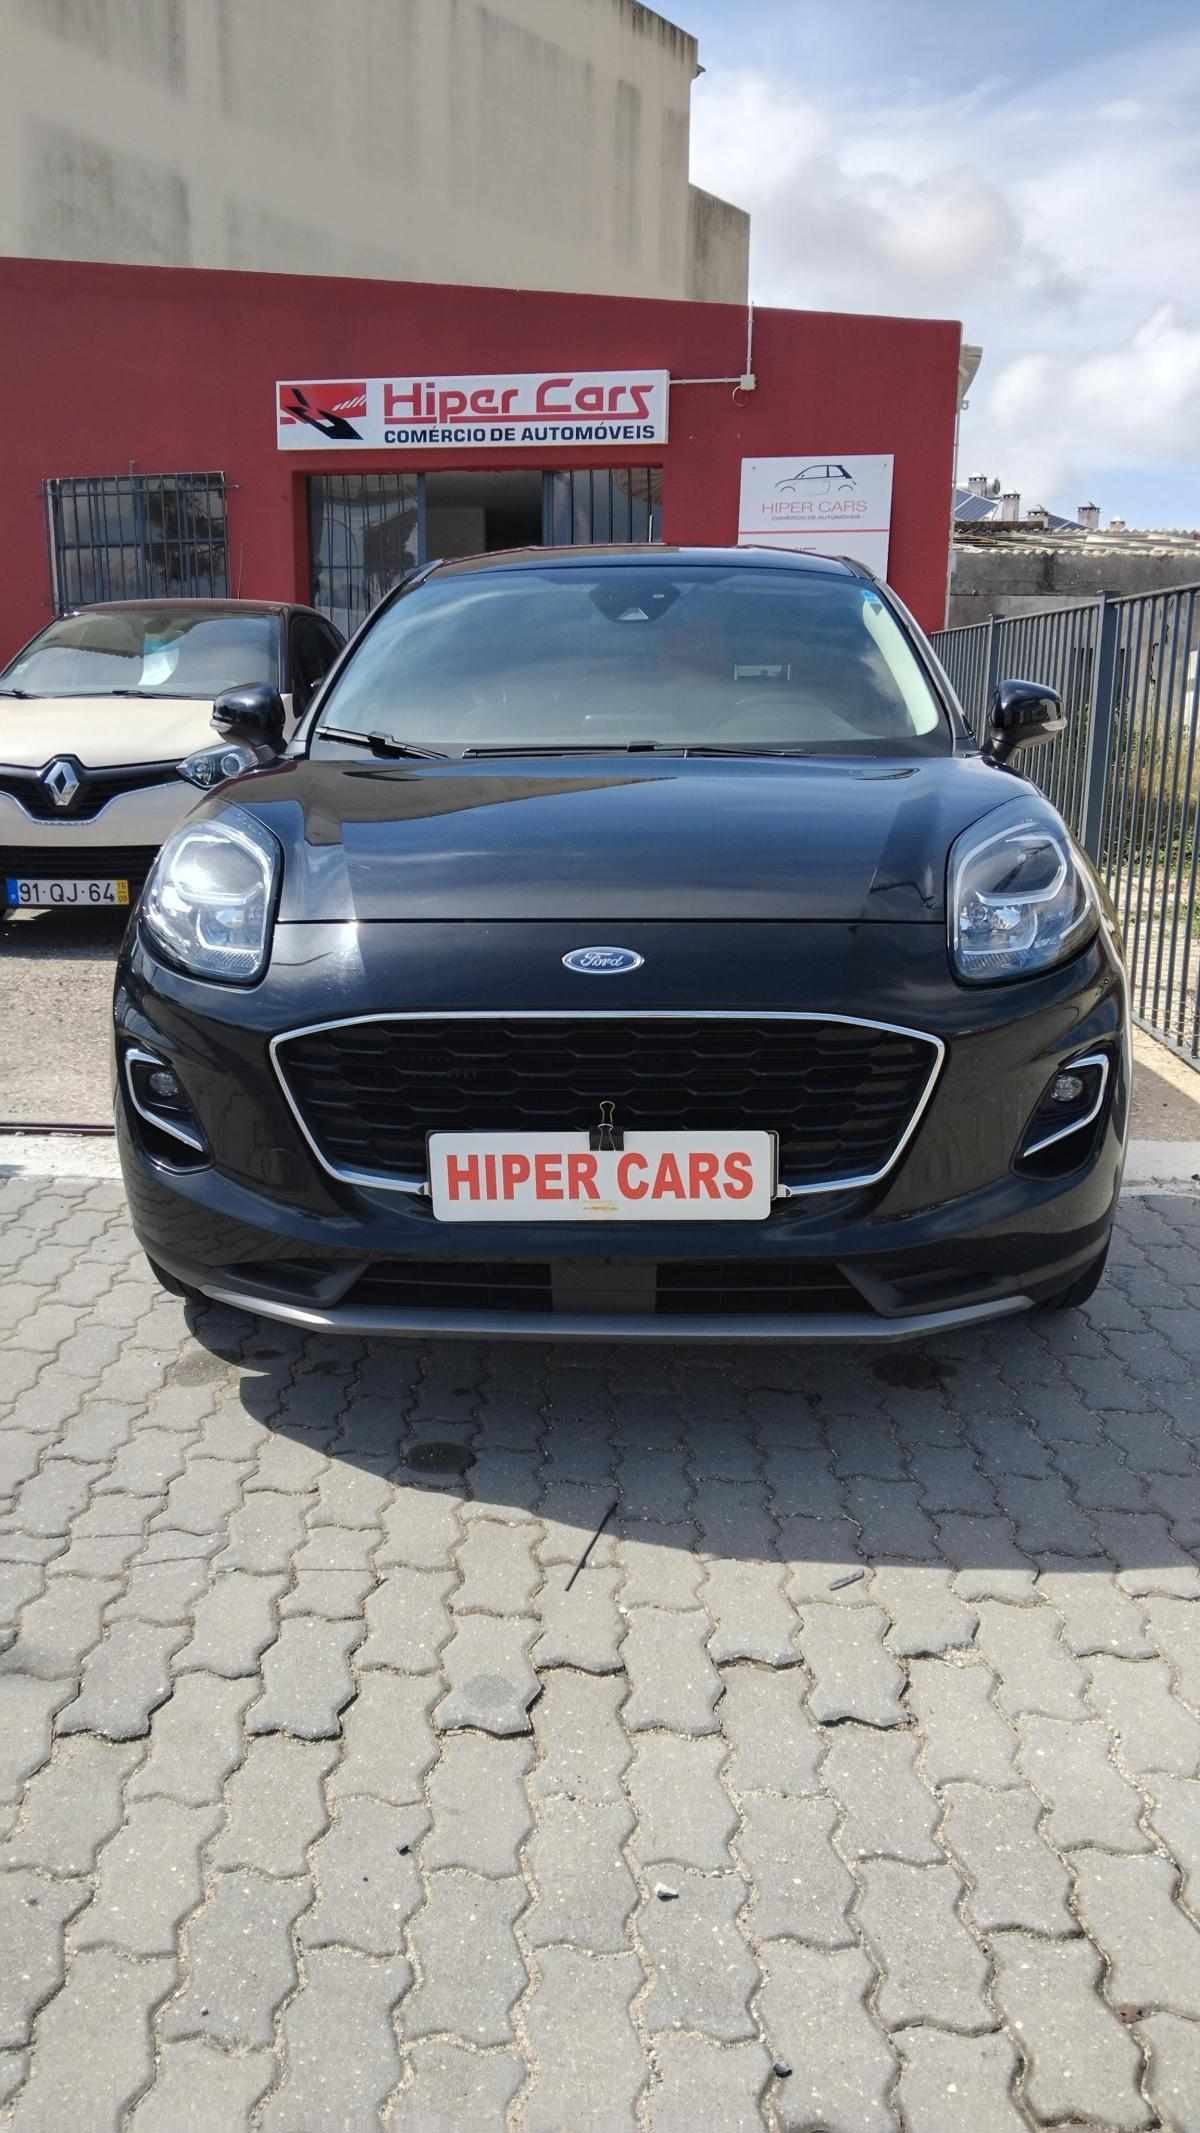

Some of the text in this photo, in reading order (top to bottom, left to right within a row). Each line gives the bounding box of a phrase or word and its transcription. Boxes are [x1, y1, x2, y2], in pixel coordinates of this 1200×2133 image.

[384, 379, 655, 424] Hiper Cars
[384, 421, 655, 443] COMÉRCIO DE AUTOMÓVEIS
[762, 500, 868, 513] HIPER CARS
[580, 952, 624, 967] Ford
[446, 1152, 754, 1200] HIPER CARS
